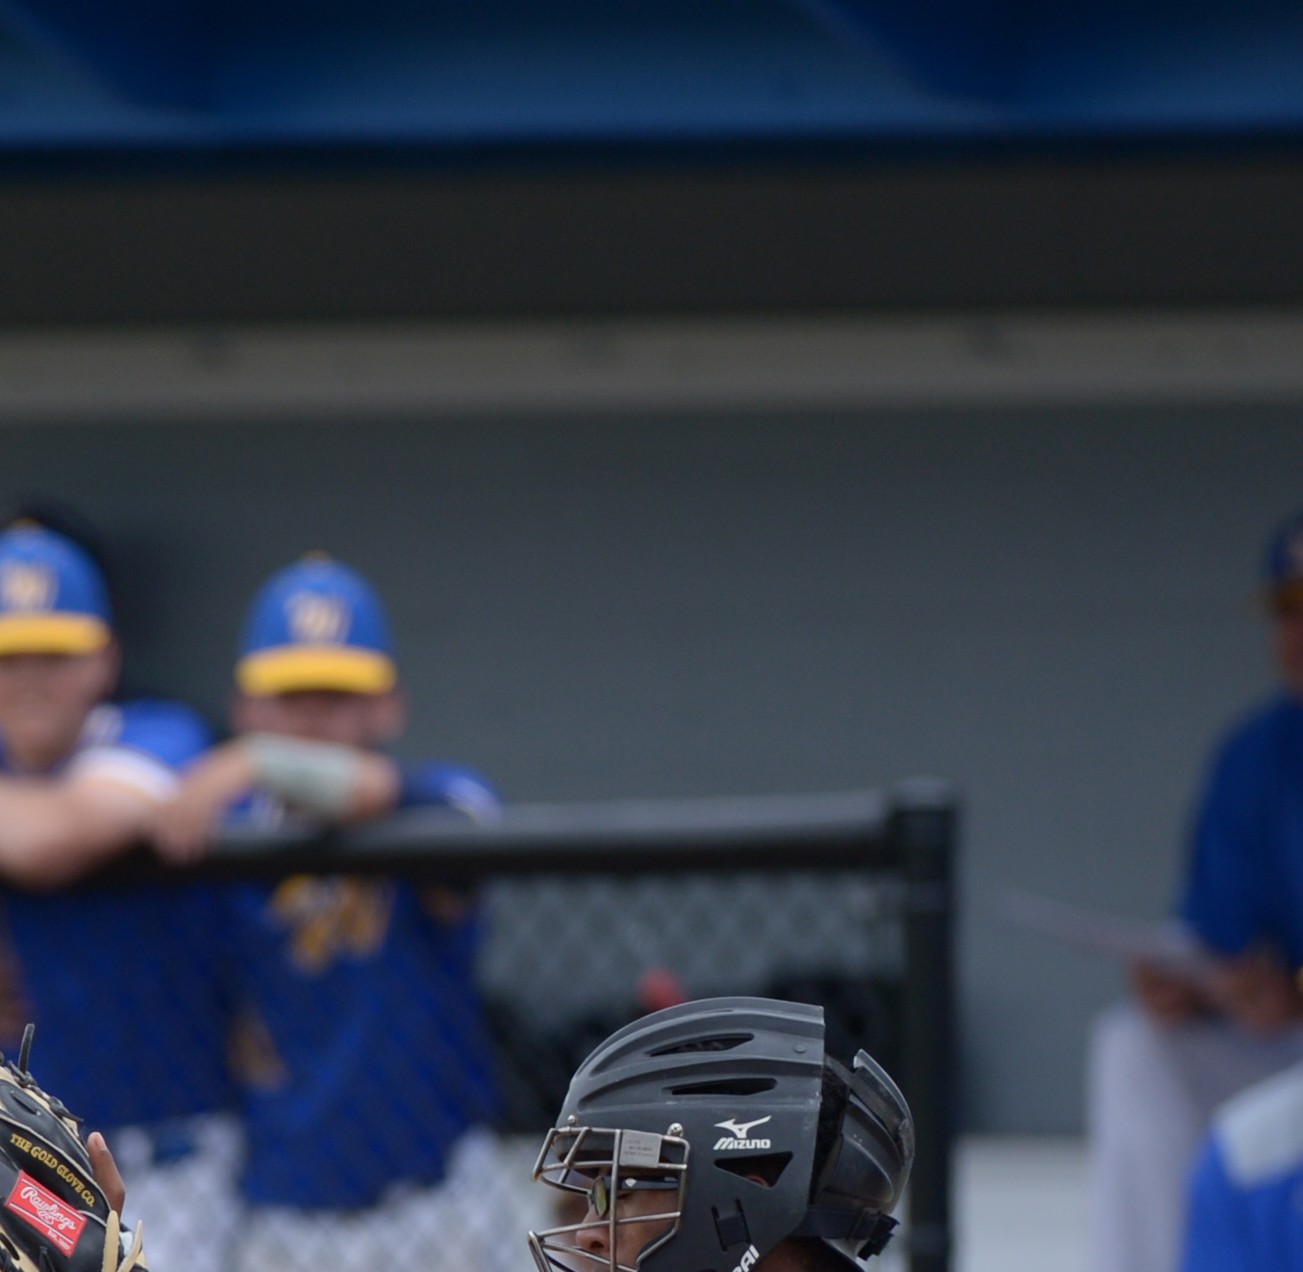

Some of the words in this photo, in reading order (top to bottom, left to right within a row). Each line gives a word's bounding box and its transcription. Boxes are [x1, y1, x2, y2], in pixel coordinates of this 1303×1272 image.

[10, 1133, 32, 1152] THE
[30, 1146, 58, 1169] GOLD
[56, 1164, 84, 1193] GLOVE
[81, 1189, 95, 1208] CO.
[20, 1186, 77, 1231] Rawlings
